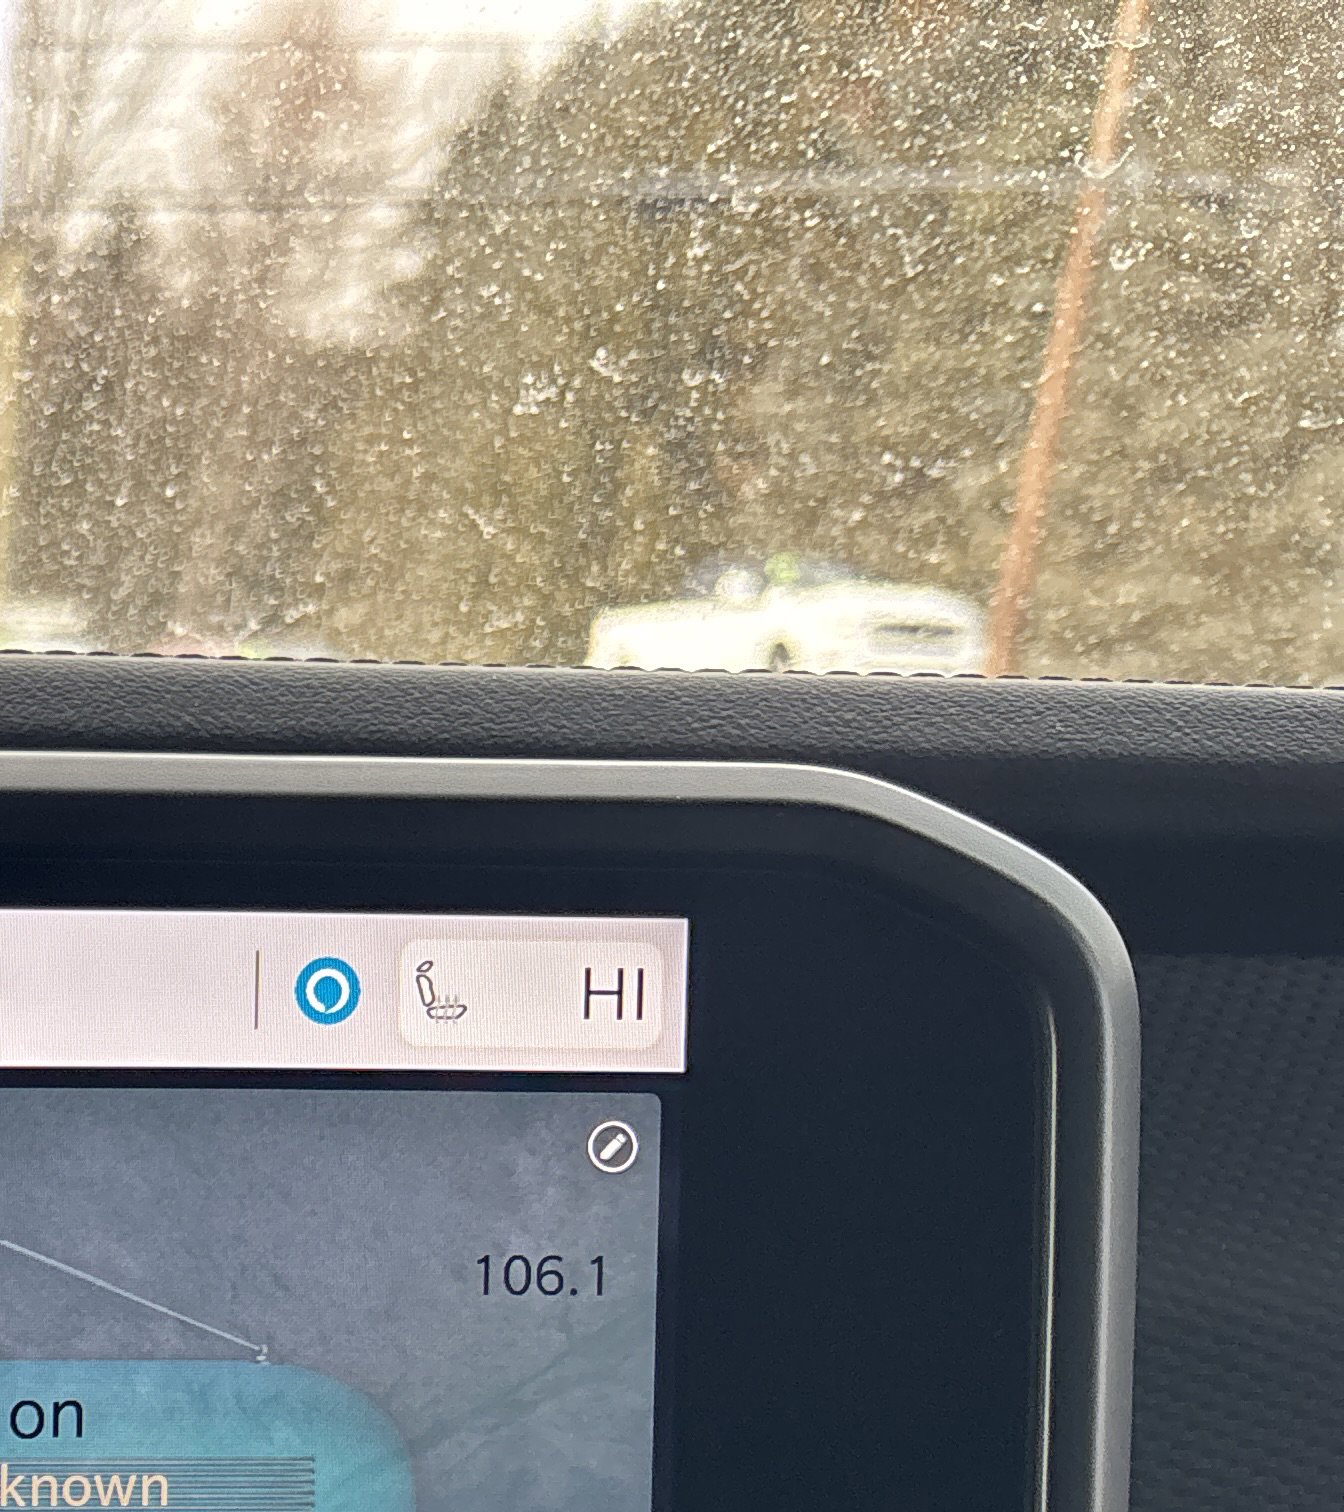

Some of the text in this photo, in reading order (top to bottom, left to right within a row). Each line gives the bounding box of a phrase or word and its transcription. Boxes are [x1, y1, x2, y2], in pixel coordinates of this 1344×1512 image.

[582, 967, 645, 1021] HI
[475, 1254, 609, 1299] 106.1
[8, 1396, 86, 1439] on
